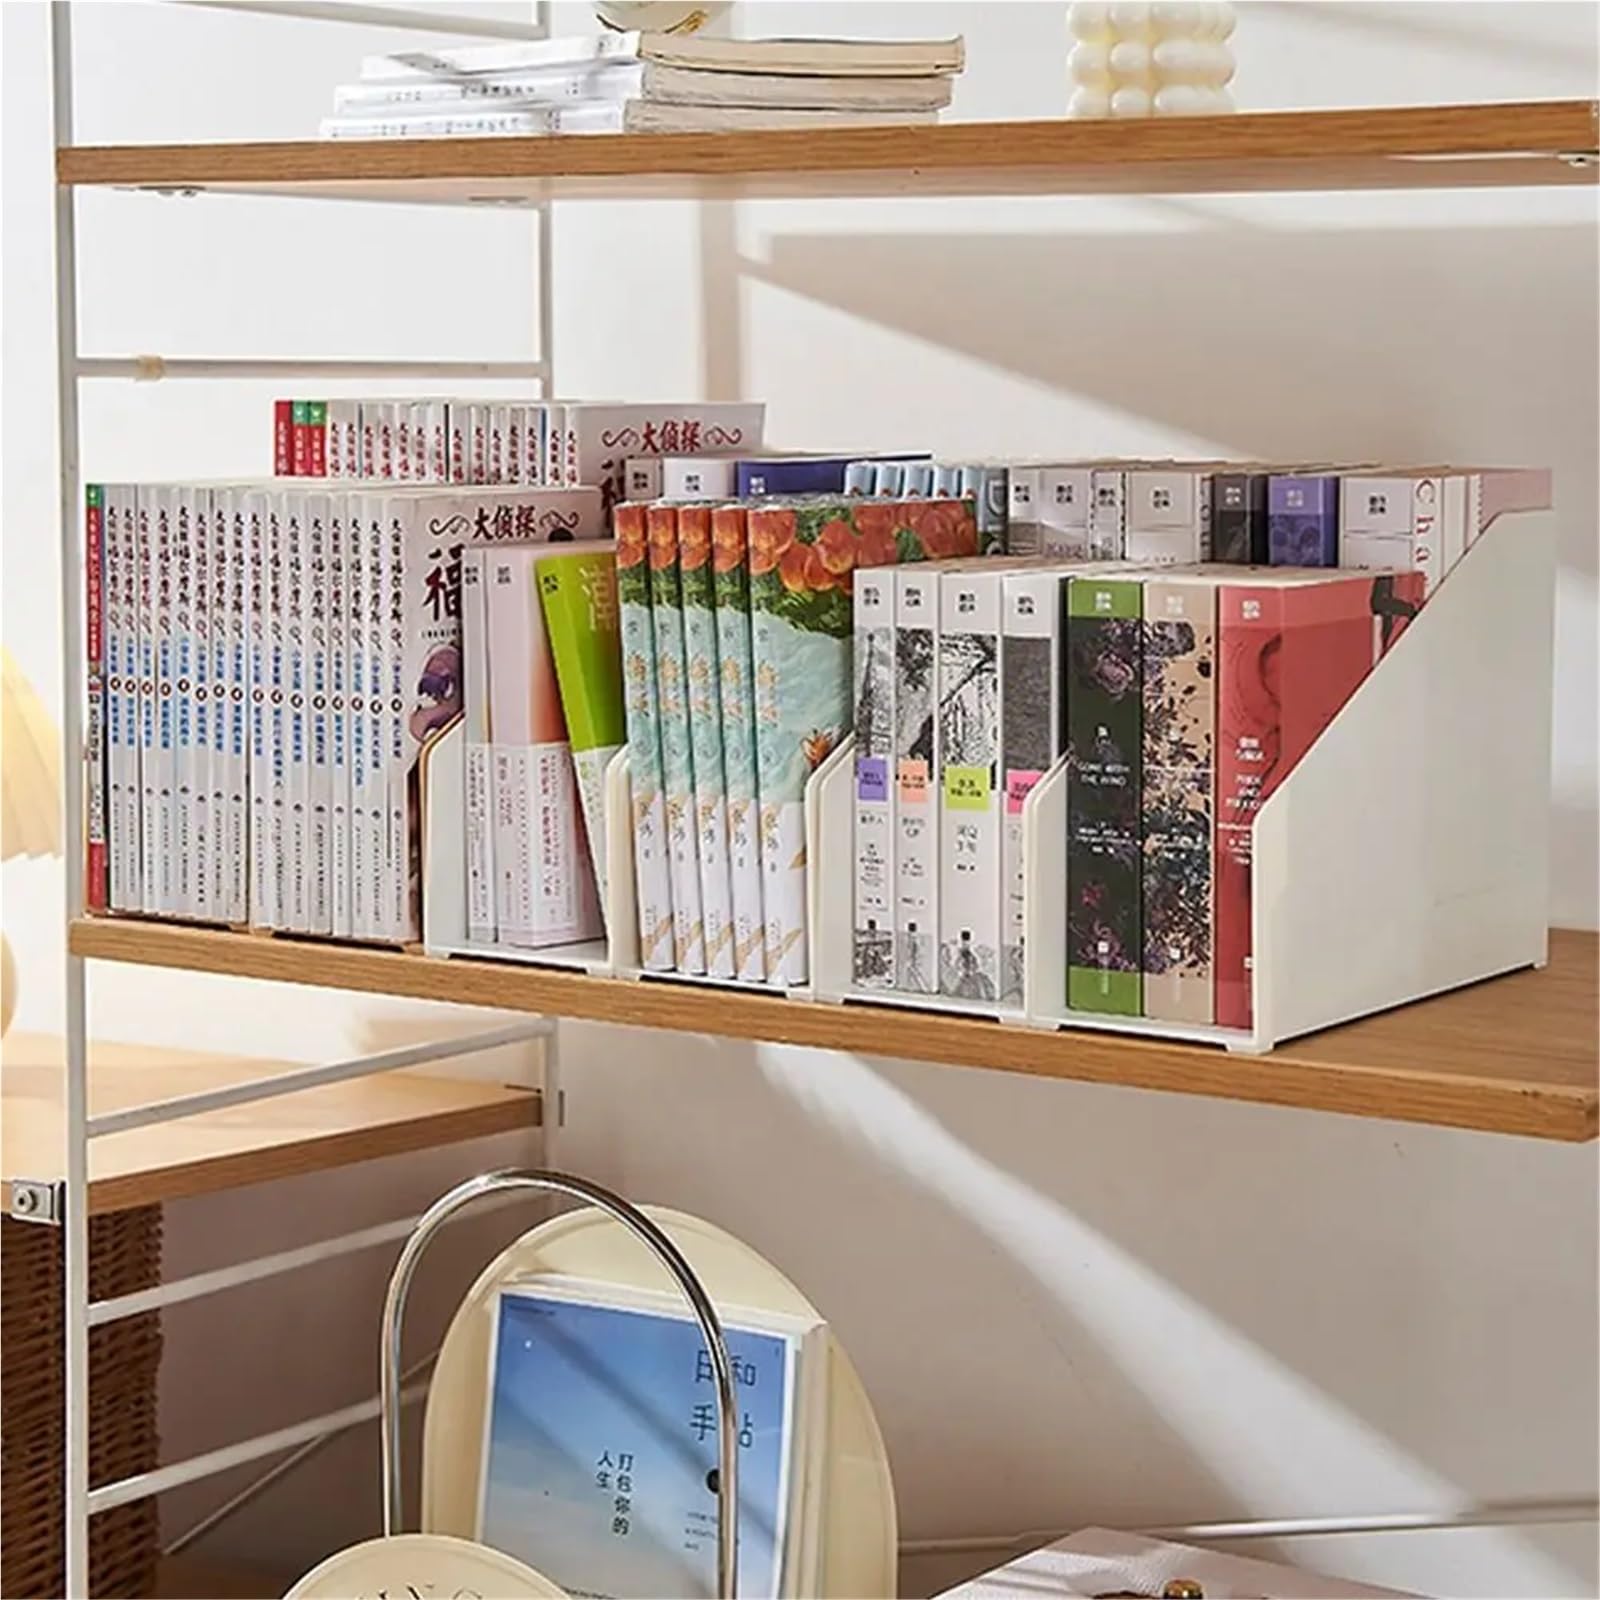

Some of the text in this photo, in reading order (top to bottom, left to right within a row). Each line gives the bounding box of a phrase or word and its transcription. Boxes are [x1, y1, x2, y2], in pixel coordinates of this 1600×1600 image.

[642, 420, 701, 454] 大侦探
[472, 504, 537, 541] 大侦探
[596, 1450, 614, 1490] 人生
